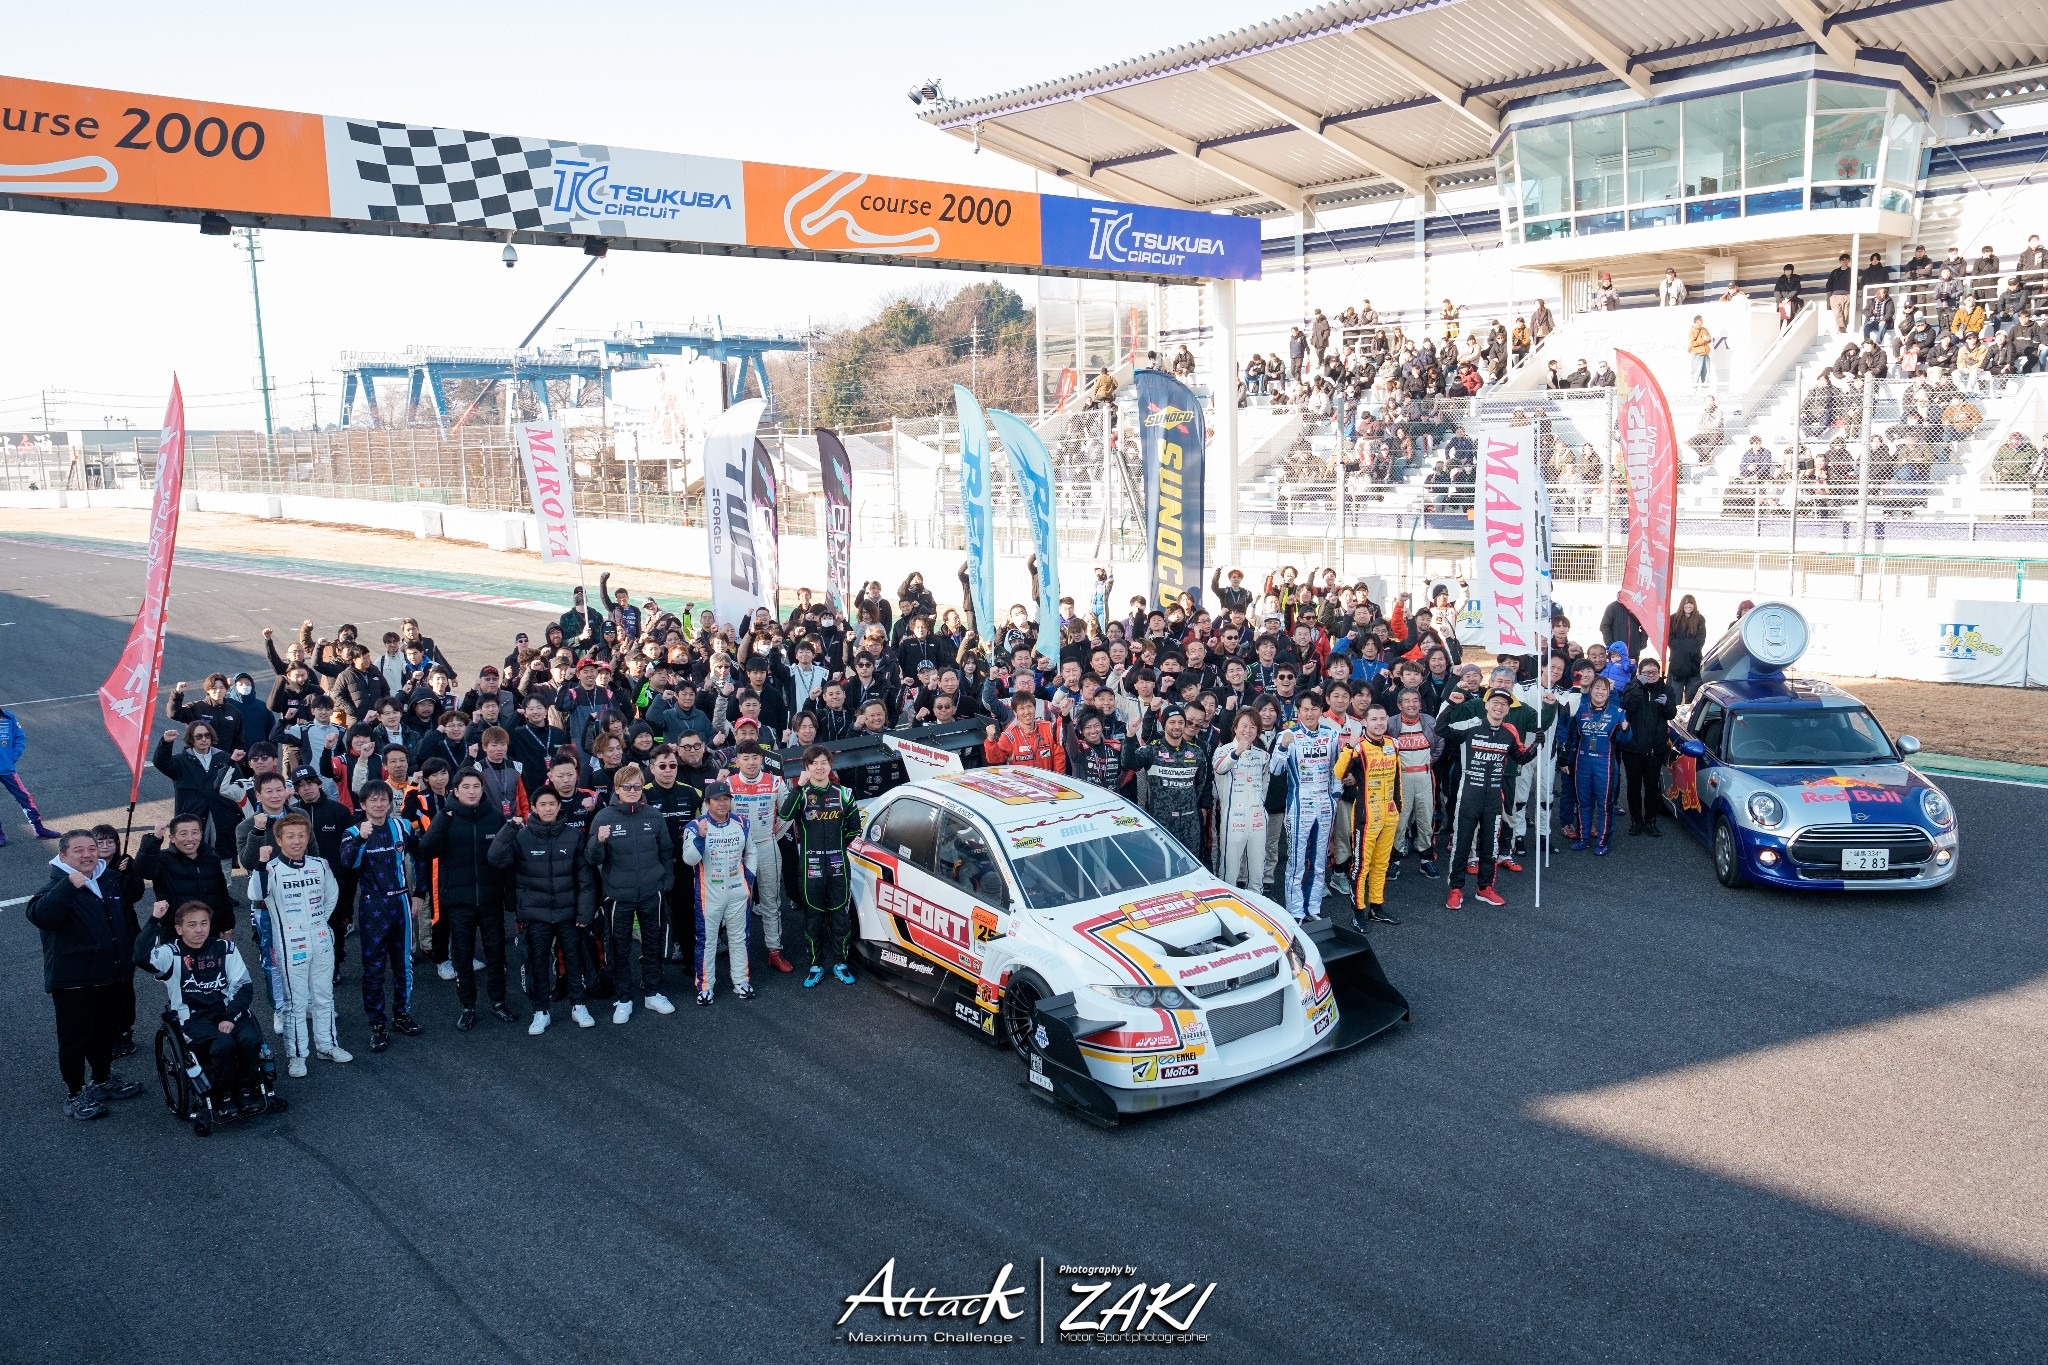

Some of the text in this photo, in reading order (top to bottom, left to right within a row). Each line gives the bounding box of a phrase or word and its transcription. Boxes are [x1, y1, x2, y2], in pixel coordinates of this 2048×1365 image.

[115, 107, 265, 161] 2000
[607, 184, 731, 211] TSUKUBA
[859, 193, 1012, 227] course 2000
[1131, 231, 1225, 256] TSUKUBA
[1144, 410, 1195, 427] SUNOCO
[524, 426, 572, 559] MAROYA
[1016, 470, 1031, 497] RACING
[1026, 500, 1042, 541] EVOLUTION
[1157, 438, 1184, 608] SUNOCO
[1484, 436, 1527, 647] MAROYA
[969, 559, 978, 585] STOPS
[1302, 747, 1328, 759] HKS
[1801, 789, 1903, 804] Red Bull
[956, 806, 975, 819] ANDO
[1060, 821, 1098, 837] BRILL
[1012, 836, 1044, 849] SUNOCO
[282, 877, 321, 889] BRIDE
[878, 883, 967, 942] ESCORT
[1129, 897, 1196, 921] ESCORT
[1179, 944, 1279, 979] Ando industry group
[955, 1001, 980, 1021] RPS
[1176, 1052, 1197, 1062] ENKEI
[1164, 1065, 1196, 1079] MoTeC
